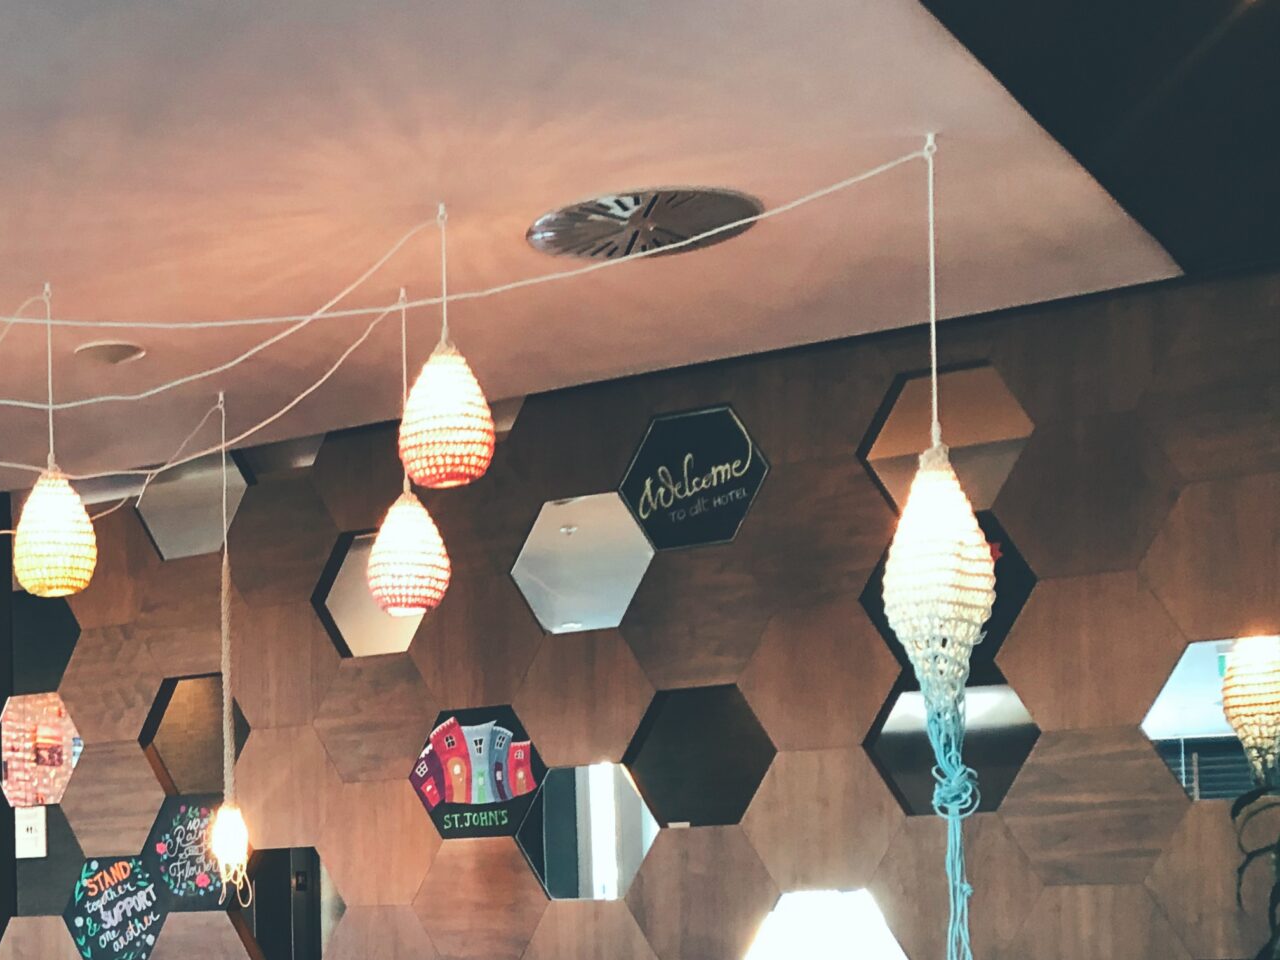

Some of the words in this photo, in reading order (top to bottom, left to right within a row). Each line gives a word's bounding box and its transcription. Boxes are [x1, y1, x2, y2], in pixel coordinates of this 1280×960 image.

[638, 451, 751, 519] Welcome
[713, 487, 747, 507] HOTEL
[87, 861, 131, 896] STAND
[84, 883, 137, 914] together
[86, 917, 102, 936] &
[101, 883, 157, 929] SUPPORT
[99, 929, 121, 948] one
[113, 911, 160, 952] another
